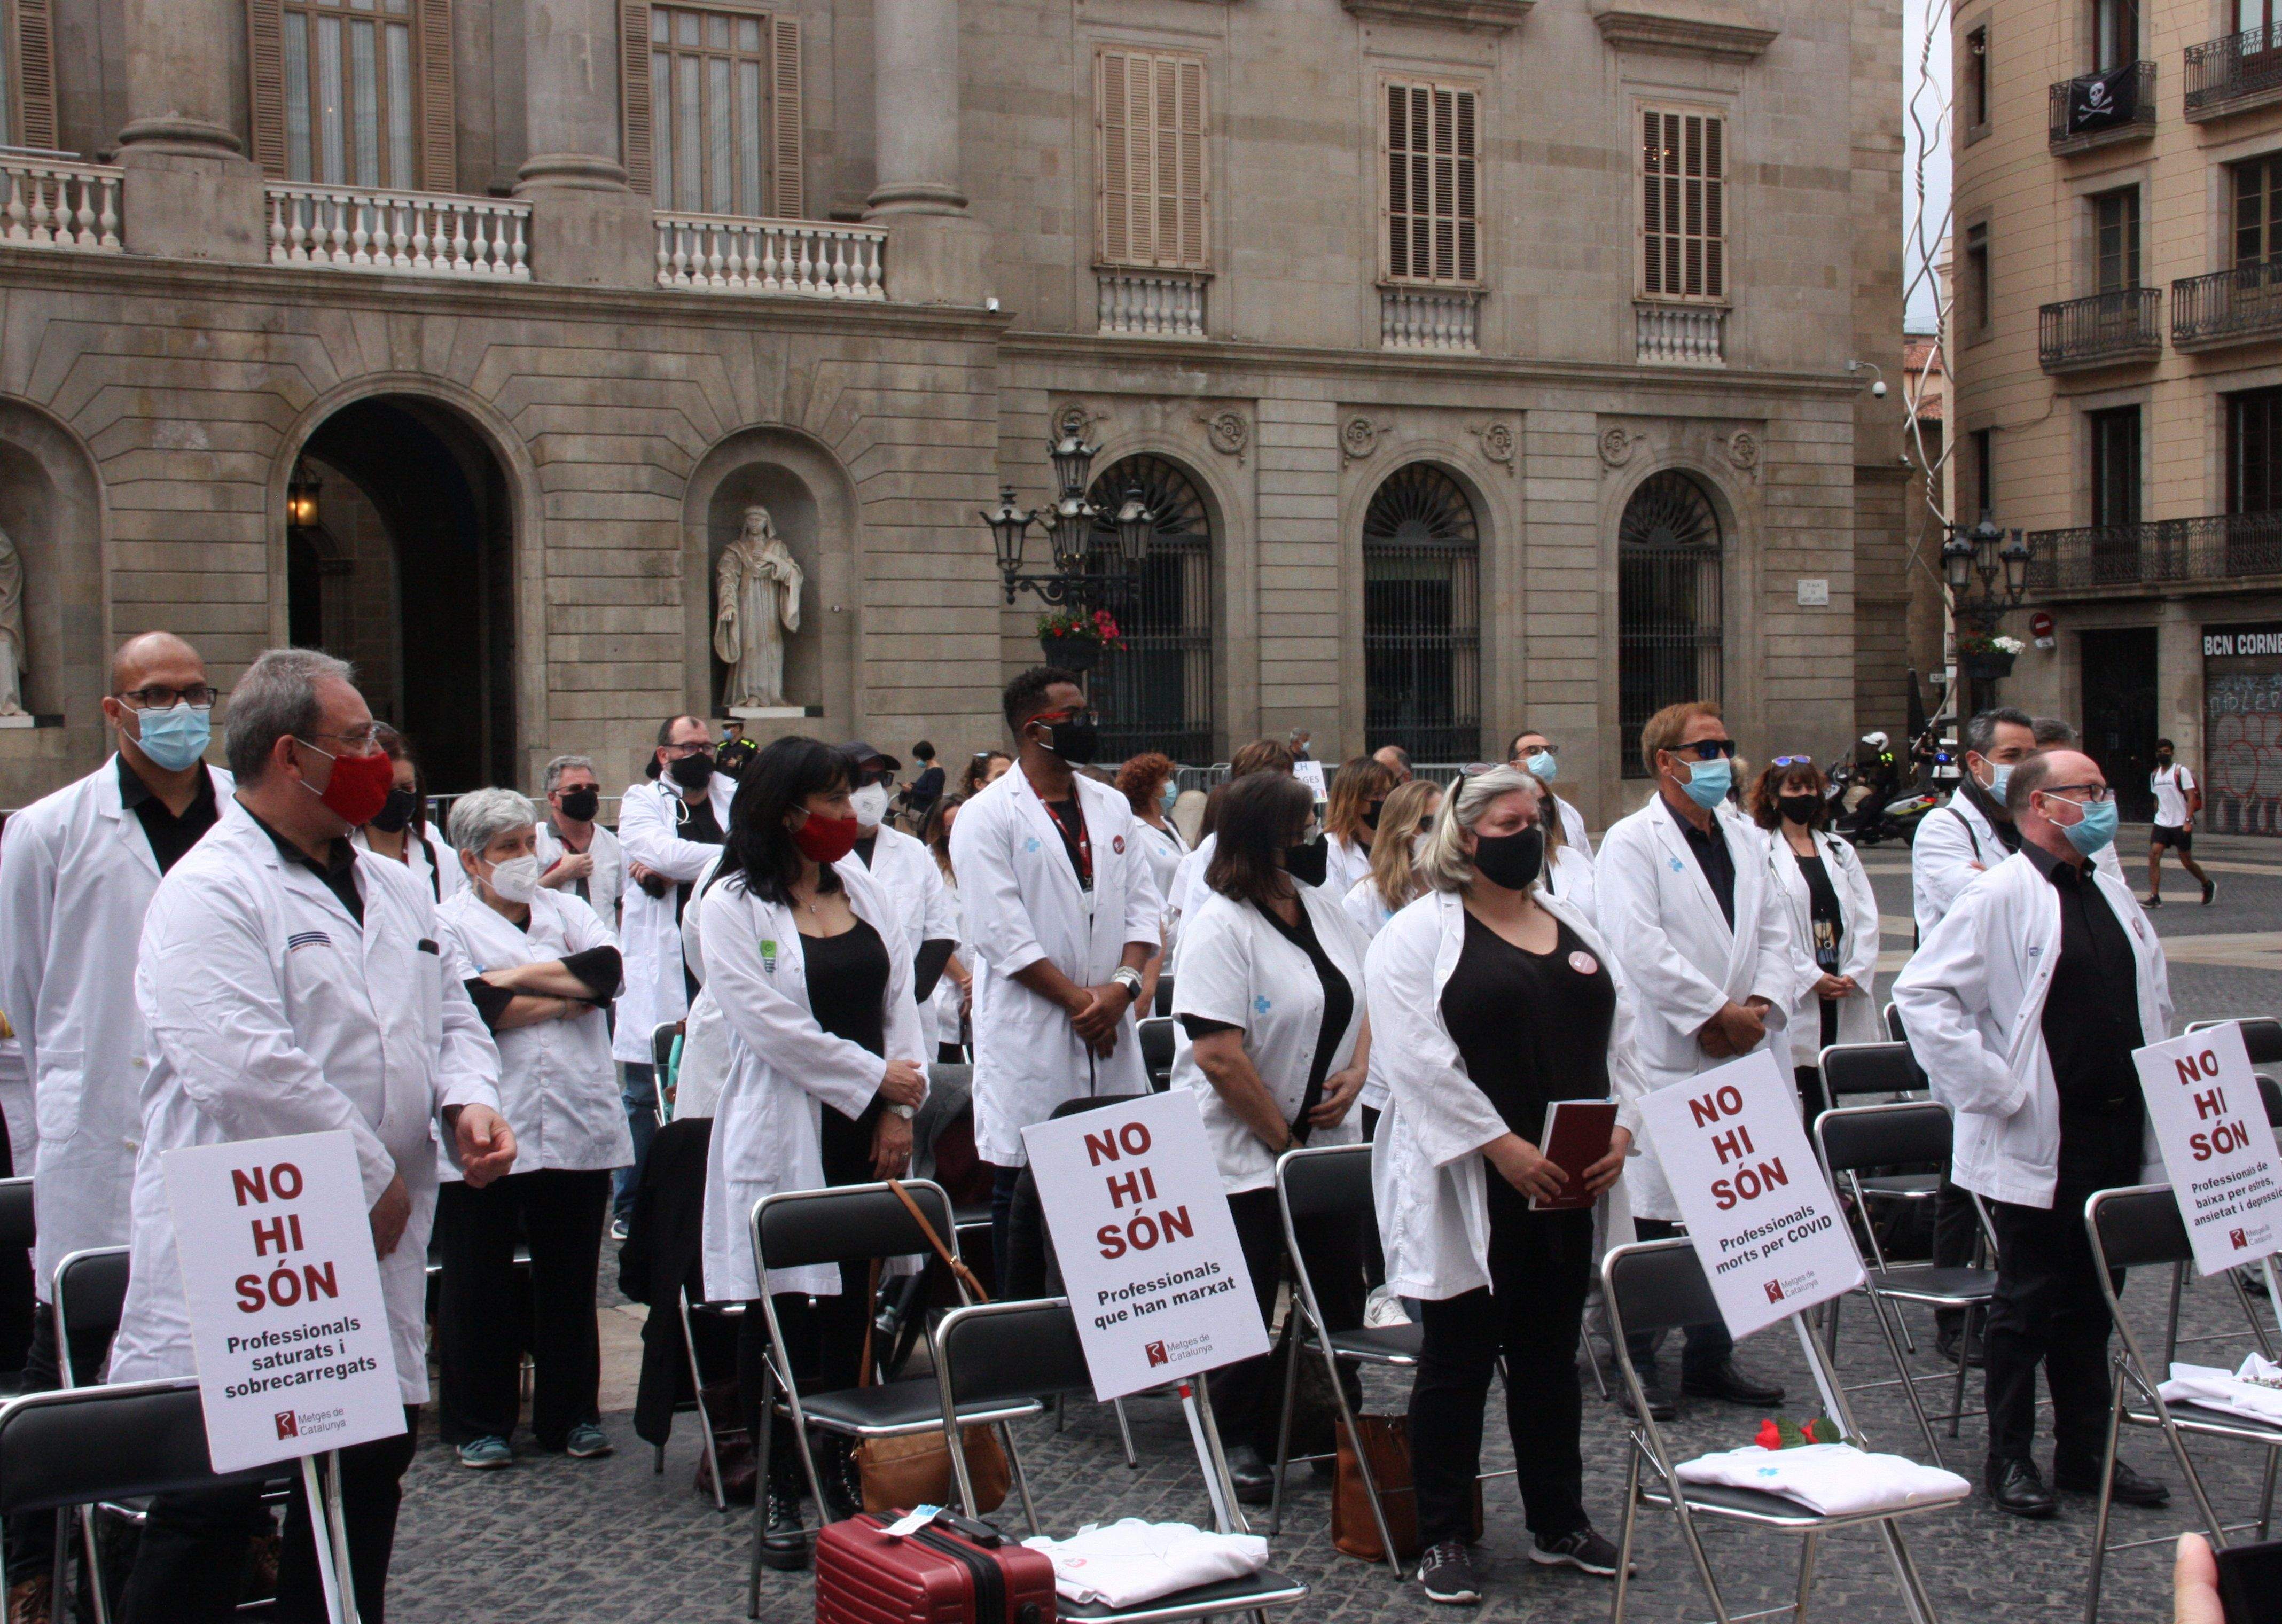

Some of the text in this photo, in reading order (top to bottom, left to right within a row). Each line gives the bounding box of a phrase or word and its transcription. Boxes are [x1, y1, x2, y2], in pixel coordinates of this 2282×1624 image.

[2203, 635, 2233, 655] BCN
[1300, 776, 1319, 784] GES
[2175, 1050, 2218, 1085] NO
[1689, 1086, 1742, 1128] NO
[2194, 1087, 2227, 1120] HI
[1084, 1122, 1151, 1166] NO
[1711, 1125, 1754, 1165] HI
[2190, 1120, 2249, 1161] SÓN
[231, 1163, 303, 1206] NO
[1106, 1167, 1157, 1208] HI
[1711, 1157, 1788, 1210] SÓN
[2192, 1162, 2268, 1193] Professionals de
[2195, 1194, 2224, 1208] baixa
[2228, 1186, 2246, 1201] per
[2195, 1205, 2237, 1226] ansietat
[2239, 1202, 2244, 1211] i
[252, 1214, 303, 1256] HI
[1097, 1205, 1194, 1259] SÓN
[1716, 1215, 1831, 1274] morts per COVID
[1720, 1206, 1814, 1252] Professionals
[235, 1259, 338, 1313] SÓN
[1098, 1262, 1220, 1306] Professionals
[1781, 1268, 1815, 1289] Metges de
[1785, 1279, 1818, 1297] Catalunya
[1095, 1277, 1236, 1330] que han marxat
[228, 1316, 360, 1353] Professionals
[1167, 1334, 1209, 1352] Metges de
[1170, 1344, 1213, 1362] Catalunya
[252, 1339, 345, 1371] saturats i
[225, 1357, 377, 1398] sobrecarregats
[298, 1407, 344, 1423] Metges de
[300, 1419, 346, 1435] Catalunya
